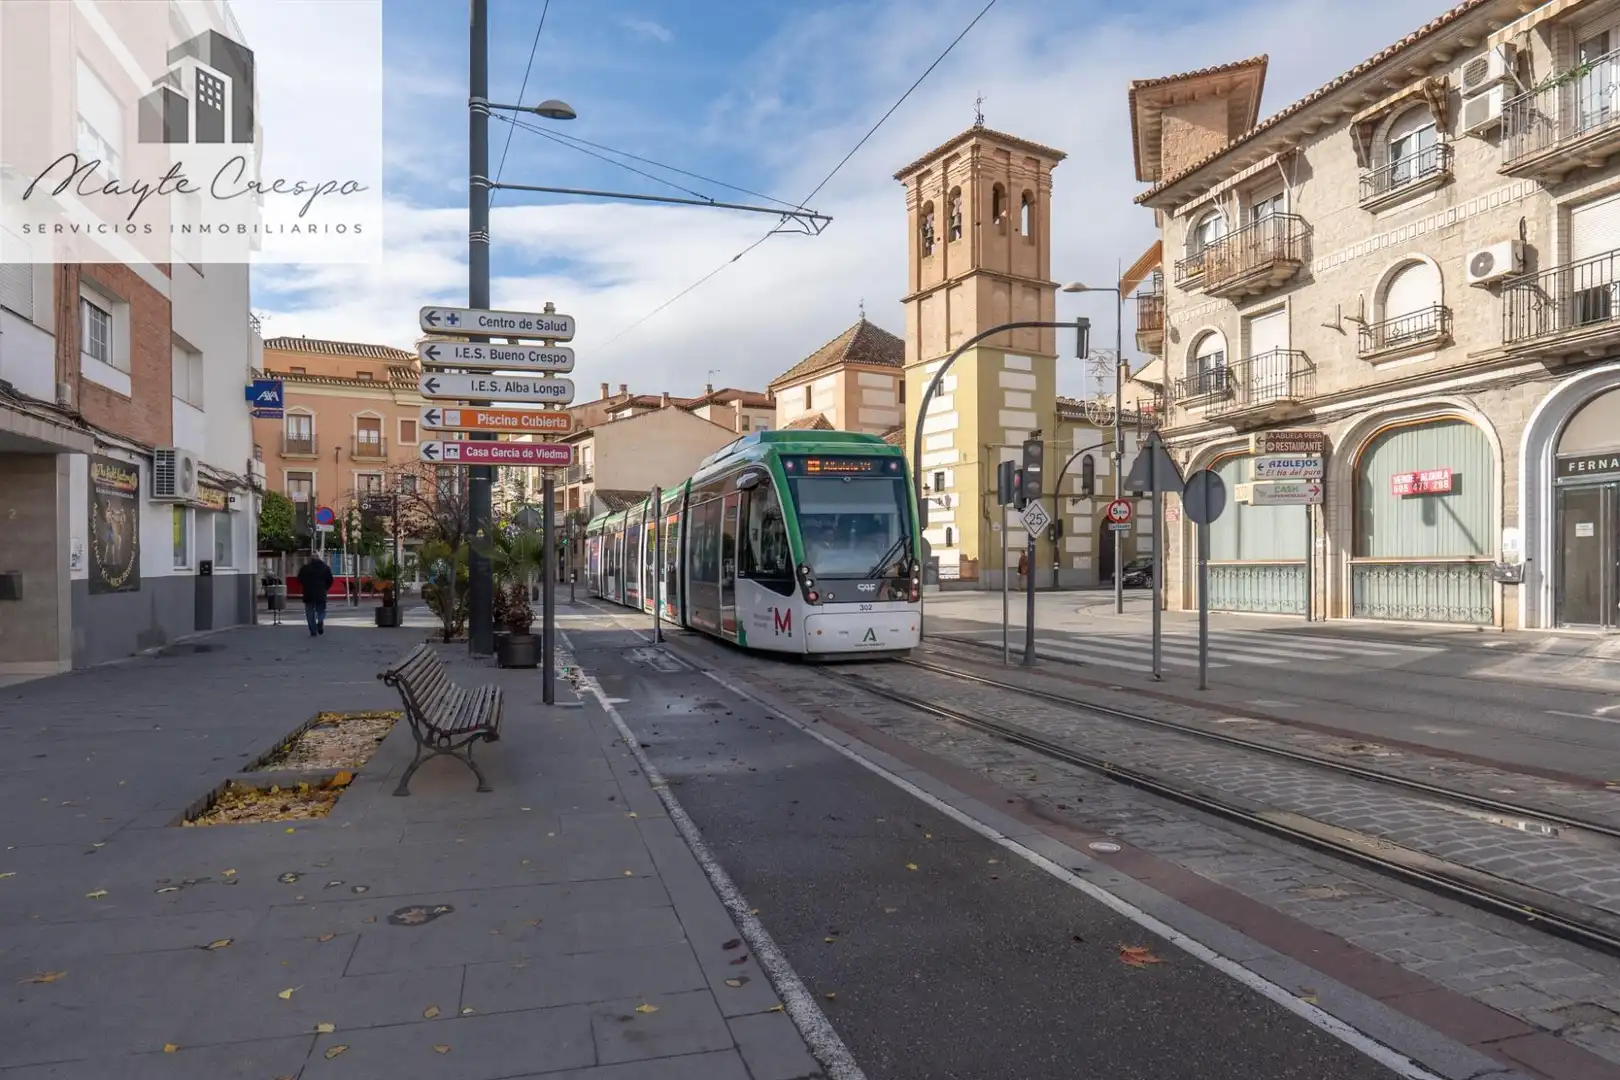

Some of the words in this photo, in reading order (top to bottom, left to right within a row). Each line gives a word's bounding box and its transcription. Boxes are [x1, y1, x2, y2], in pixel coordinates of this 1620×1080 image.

[478, 316, 515, 329] Centro
[519, 318, 532, 329] de
[536, 319, 567, 332] Salud
[455, 347, 486, 359] I.E.S.
[490, 349, 525, 361] Bueno
[528, 350, 567, 365] Crespo
[471, 380, 501, 392] I.E.S.
[505, 382, 529, 394] Alba
[533, 383, 566, 396] Longa
[257, 390, 280, 402] AXA
[477, 413, 518, 426] Piscina
[521, 415, 567, 428] Cubierta
[466, 446, 489, 457] Casa
[522, 448, 534, 458] de
[536, 448, 568, 460] Viedma
[1275, 441, 1322, 451] RESTAURANTE
[1268, 459, 1318, 469] AZULEJOS
[1568, 458, 1619, 472] FERNA
[1274, 485, 1299, 493] CASH
[1029, 512, 1043, 525] 25
[859, 603, 873, 611] 302
[774, 607, 792, 633] M
